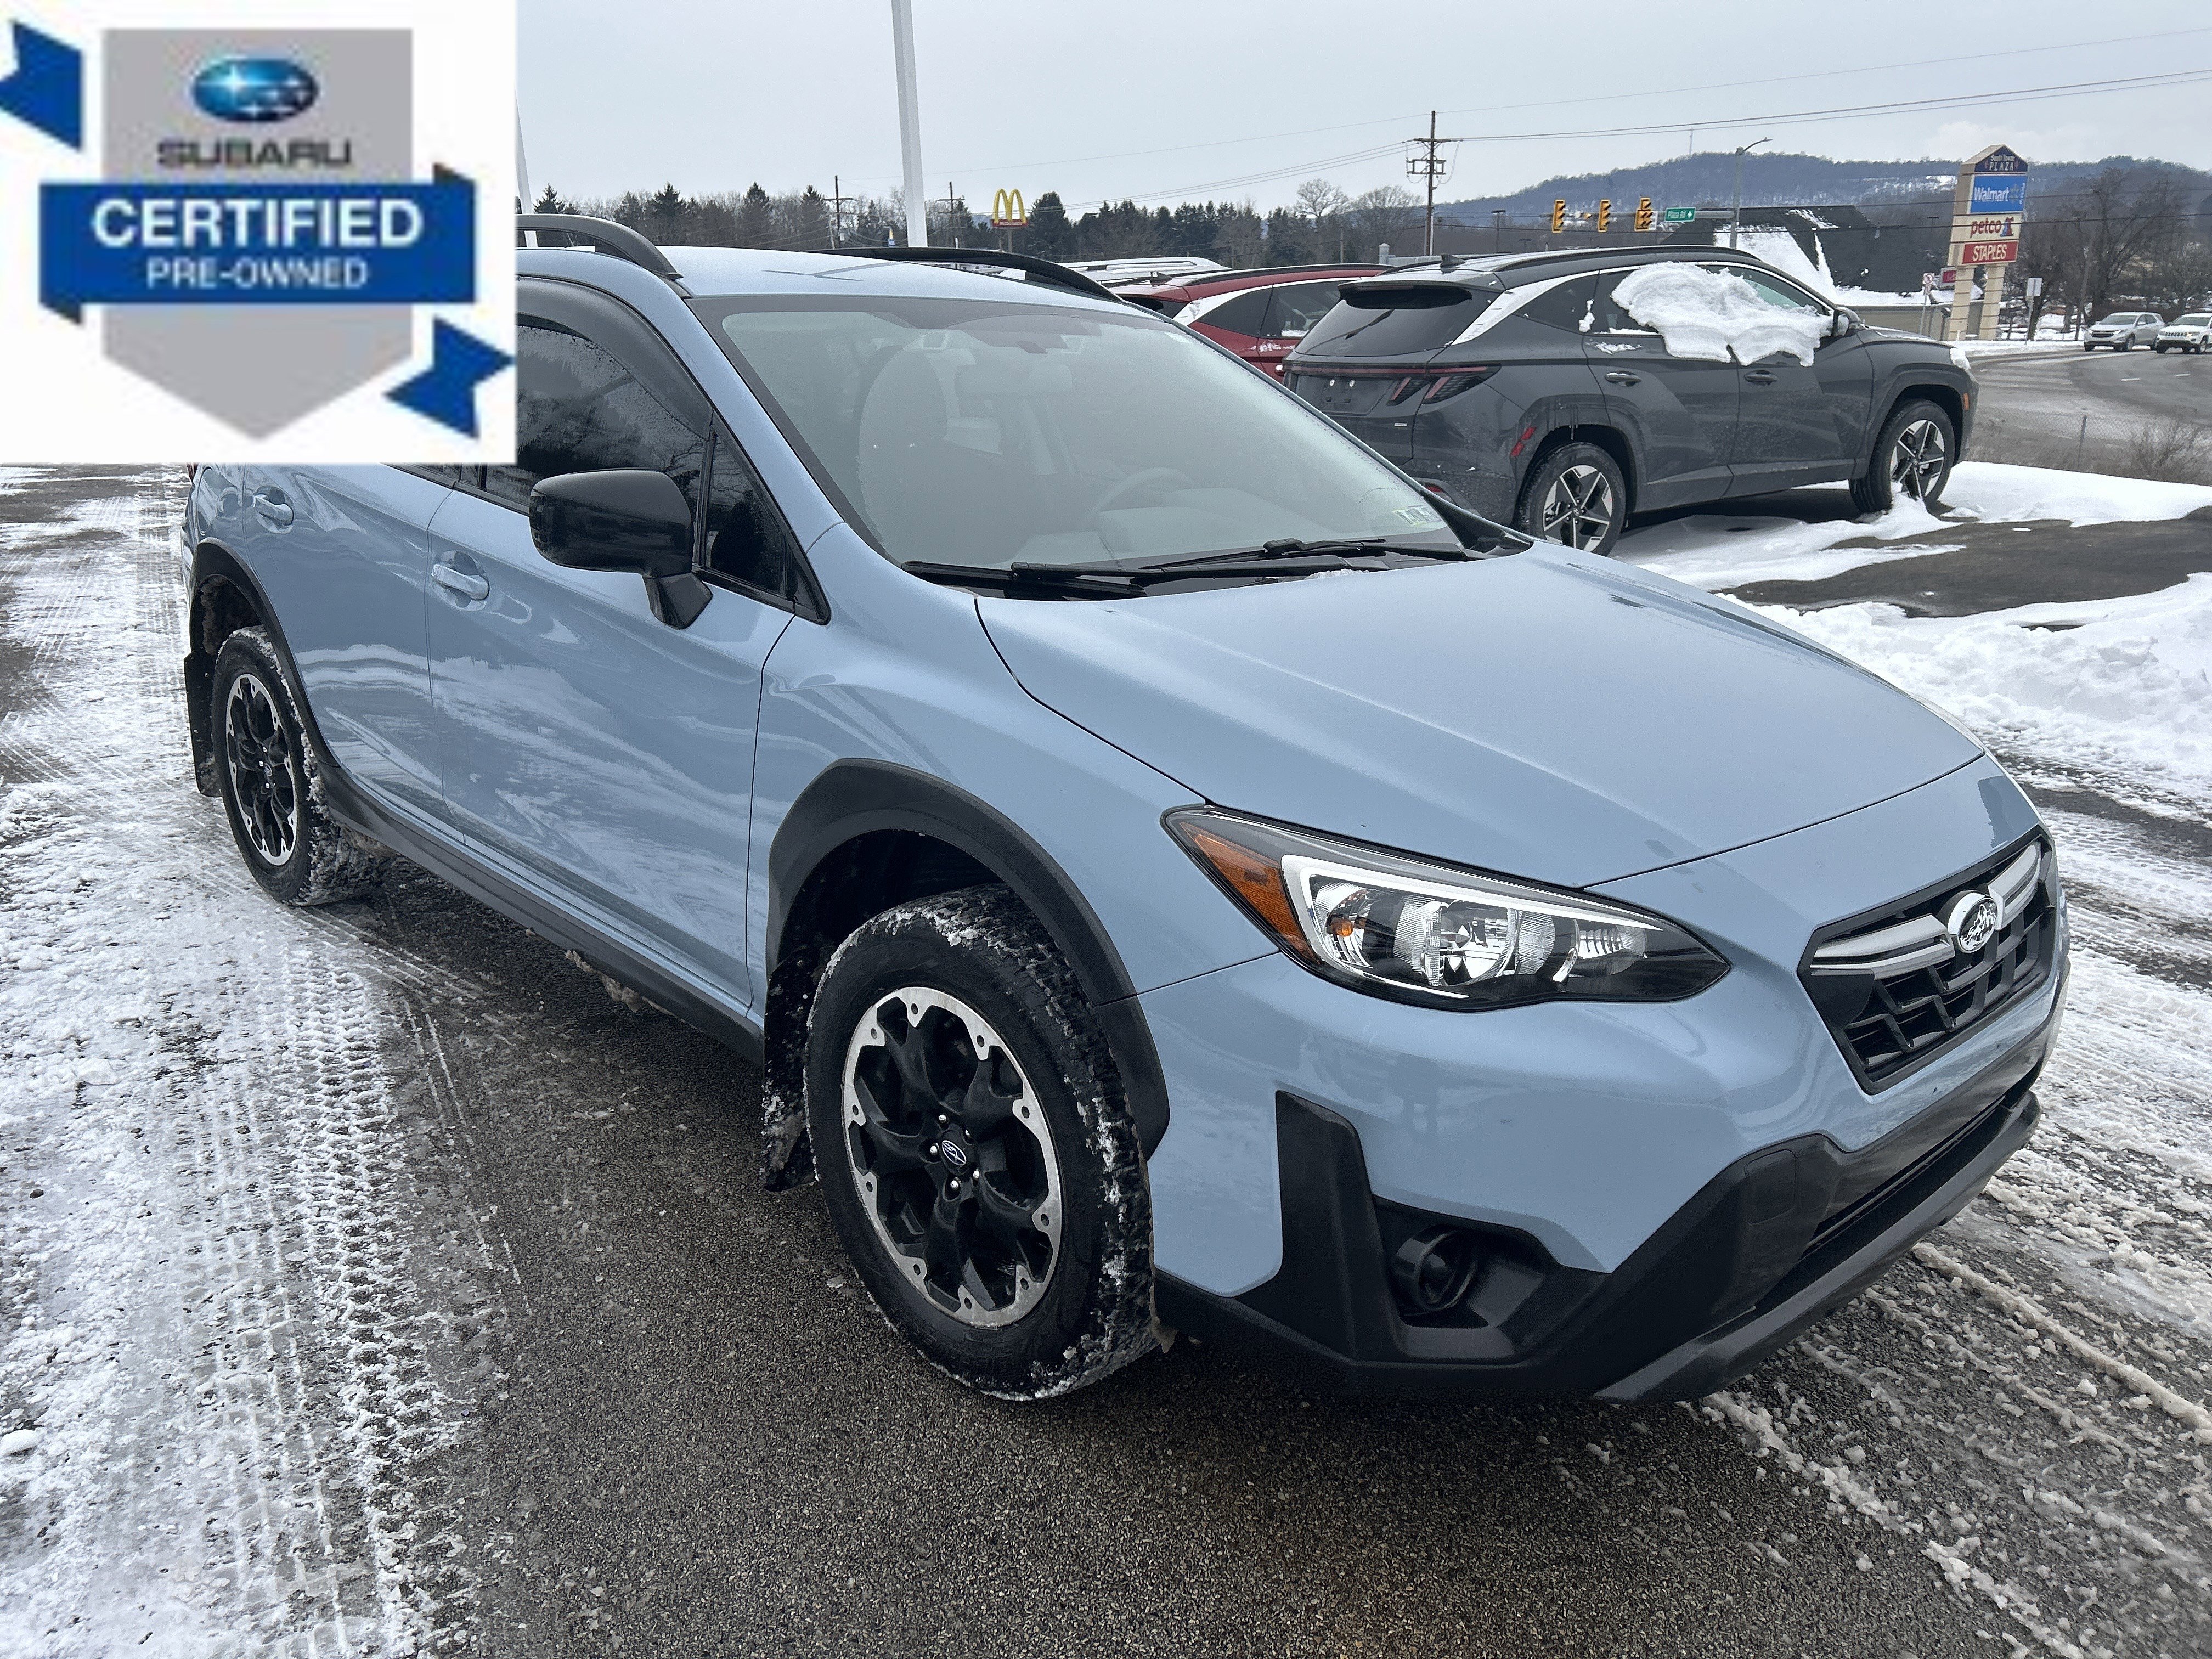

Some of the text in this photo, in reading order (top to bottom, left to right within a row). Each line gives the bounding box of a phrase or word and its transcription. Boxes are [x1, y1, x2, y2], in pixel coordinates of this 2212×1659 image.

[1989, 162, 2014, 171] PLAZA
[1974, 187, 2009, 201] Walmart
[1970, 218, 2001, 238] petco
[1972, 244, 2007, 261] STAPLES
